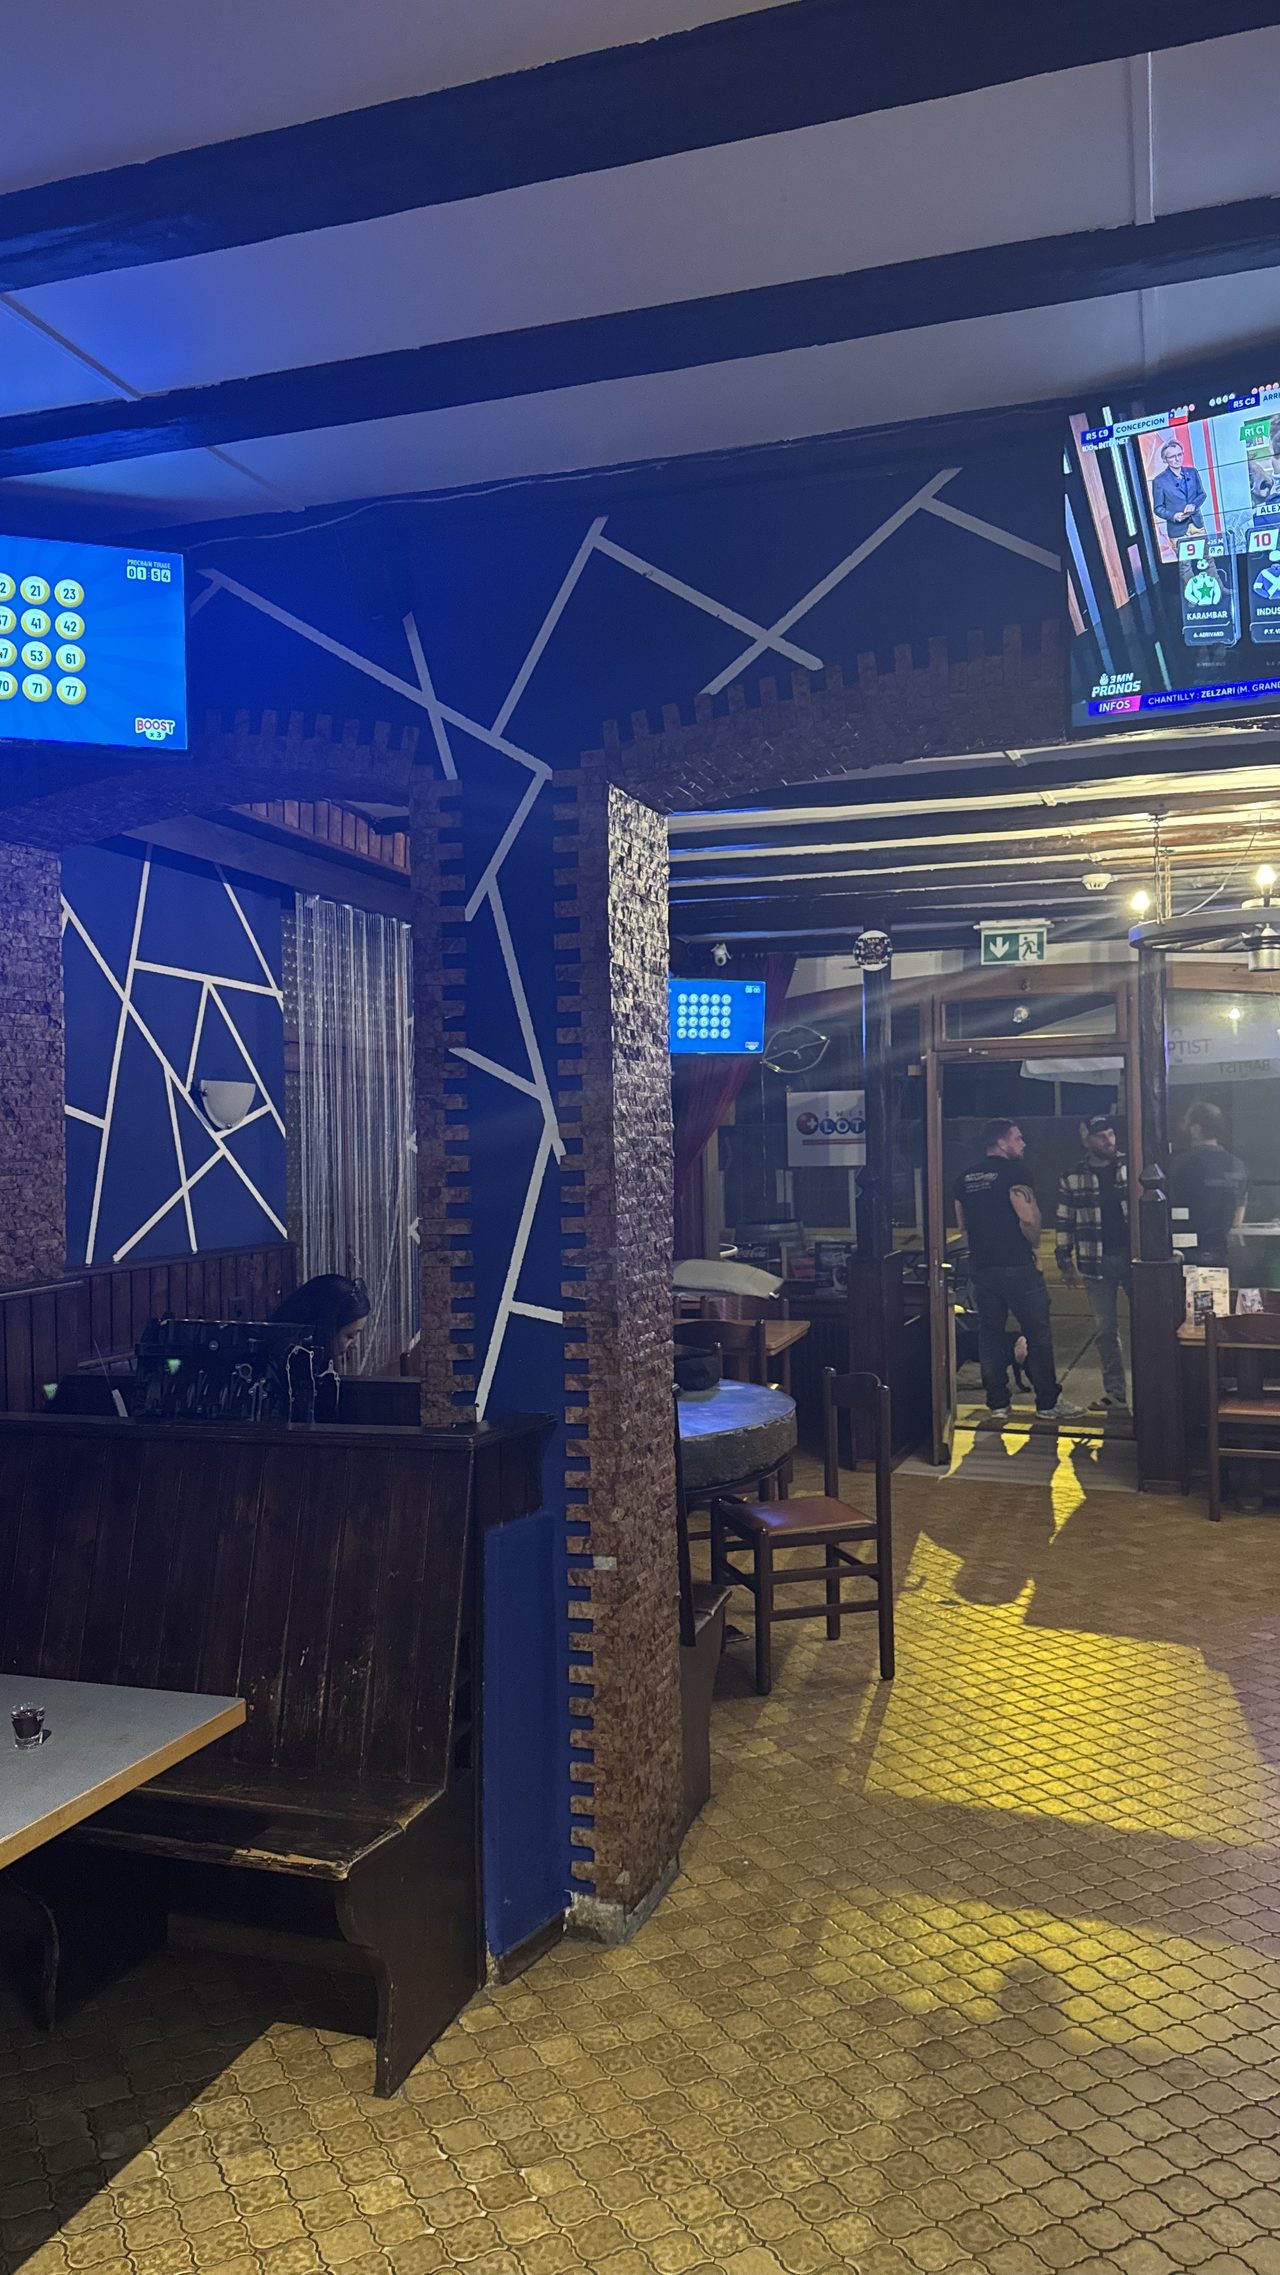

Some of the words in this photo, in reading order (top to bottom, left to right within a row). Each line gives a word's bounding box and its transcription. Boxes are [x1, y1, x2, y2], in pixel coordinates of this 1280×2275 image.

[1233, 400, 1244, 409] R5
[1244, 397, 1256, 406] C8
[1115, 417, 1166, 434] CONCEPCION
[1244, 427, 1255, 437] R1
[1255, 425, 1265, 434] C1
[1085, 431, 1097, 441] R5
[1098, 428, 1109, 439] C9
[1254, 532, 1272, 548] 10
[1186, 543, 1196, 556] 9
[127, 559, 153, 567] PROCHAIN
[30, 584, 41, 597] 21
[63, 588, 76, 600] 23
[1186, 610, 1228, 621] KARAMBAR
[31, 617, 42, 629] 41
[63, 620, 77, 633] 42
[30, 650, 43, 662] 53
[65, 652, 76, 665] 61
[32, 682, 43, 695] 71
[65, 685, 78, 697] 77
[1091, 680, 1142, 698] PRONOS
[1148, 691, 1195, 705] CHANTILLY
[1200, 687, 1236, 699] ZELZARI
[1236, 685, 1250, 696] (M.
[1098, 700, 1131, 713] INFOS
[136, 719, 174, 733] BOOST
[1167, 1038, 1212, 1056] PTIST
